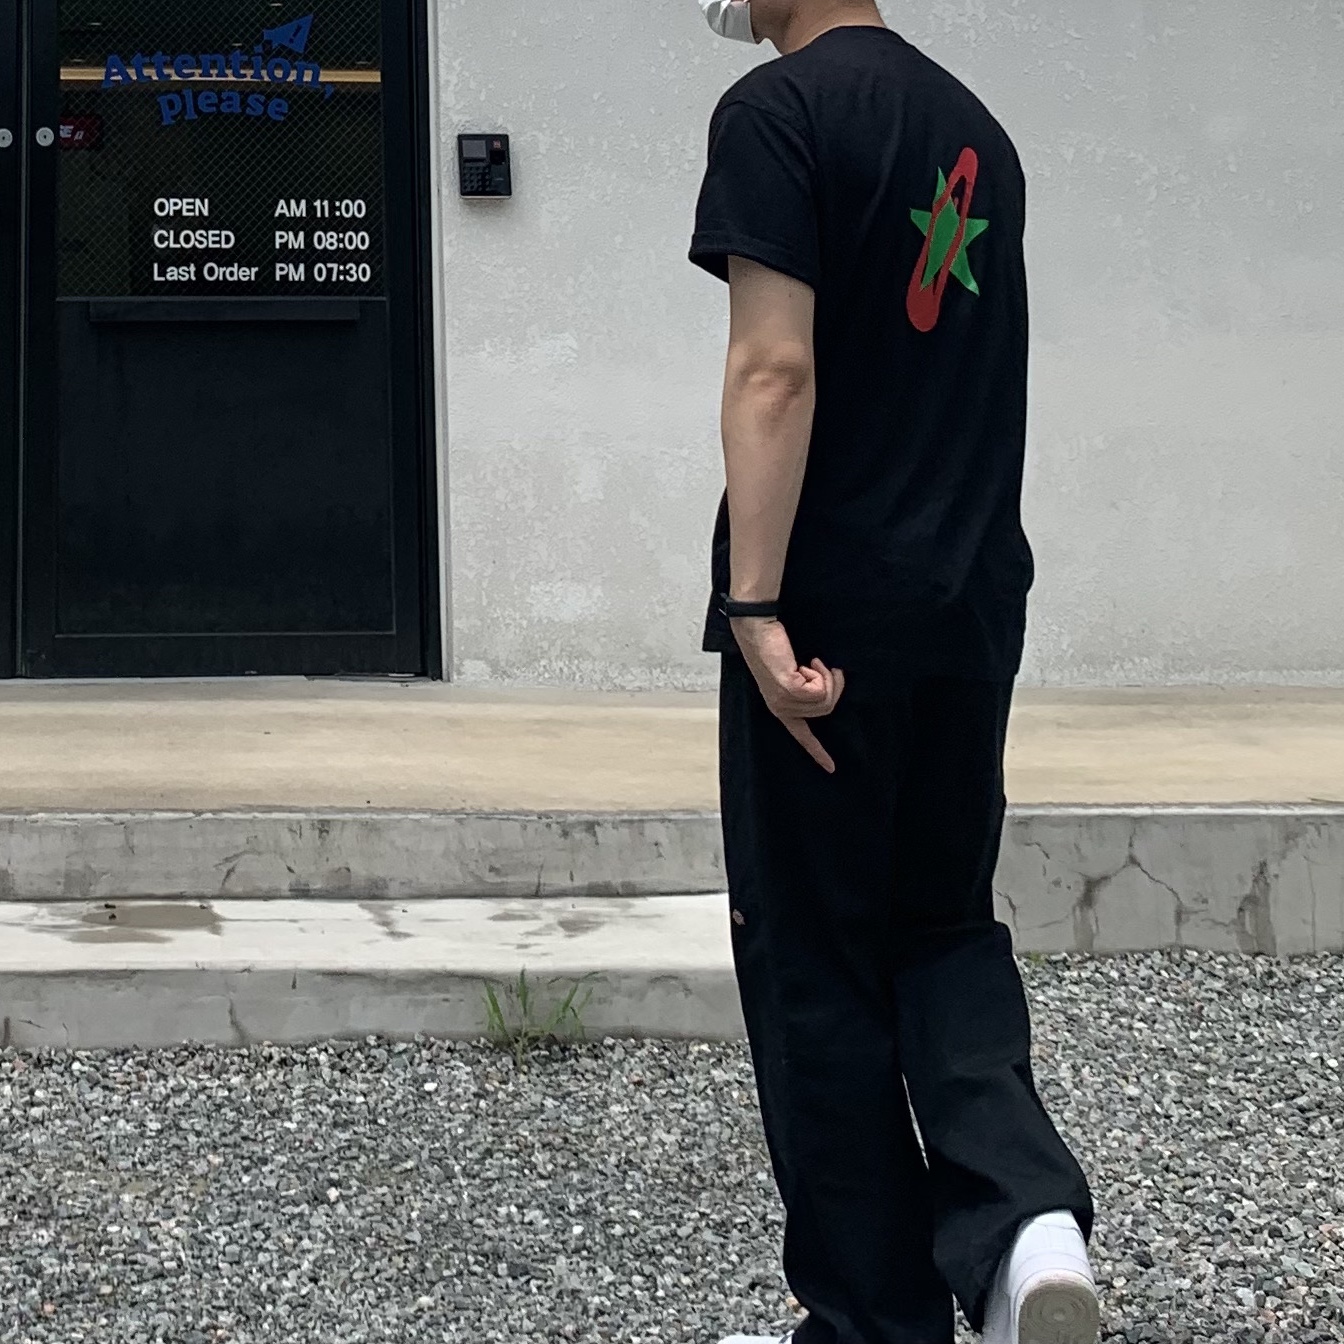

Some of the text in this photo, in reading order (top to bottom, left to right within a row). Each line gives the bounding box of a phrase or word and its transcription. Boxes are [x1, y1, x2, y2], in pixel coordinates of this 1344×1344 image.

[101, 46, 336, 100] Attention,
[157, 87, 290, 126] please
[153, 198, 367, 219] OPEN AM 11:00
[153, 230, 370, 251] CLOSED PM 08:00
[152, 263, 371, 282] Last Order PM 07:30
